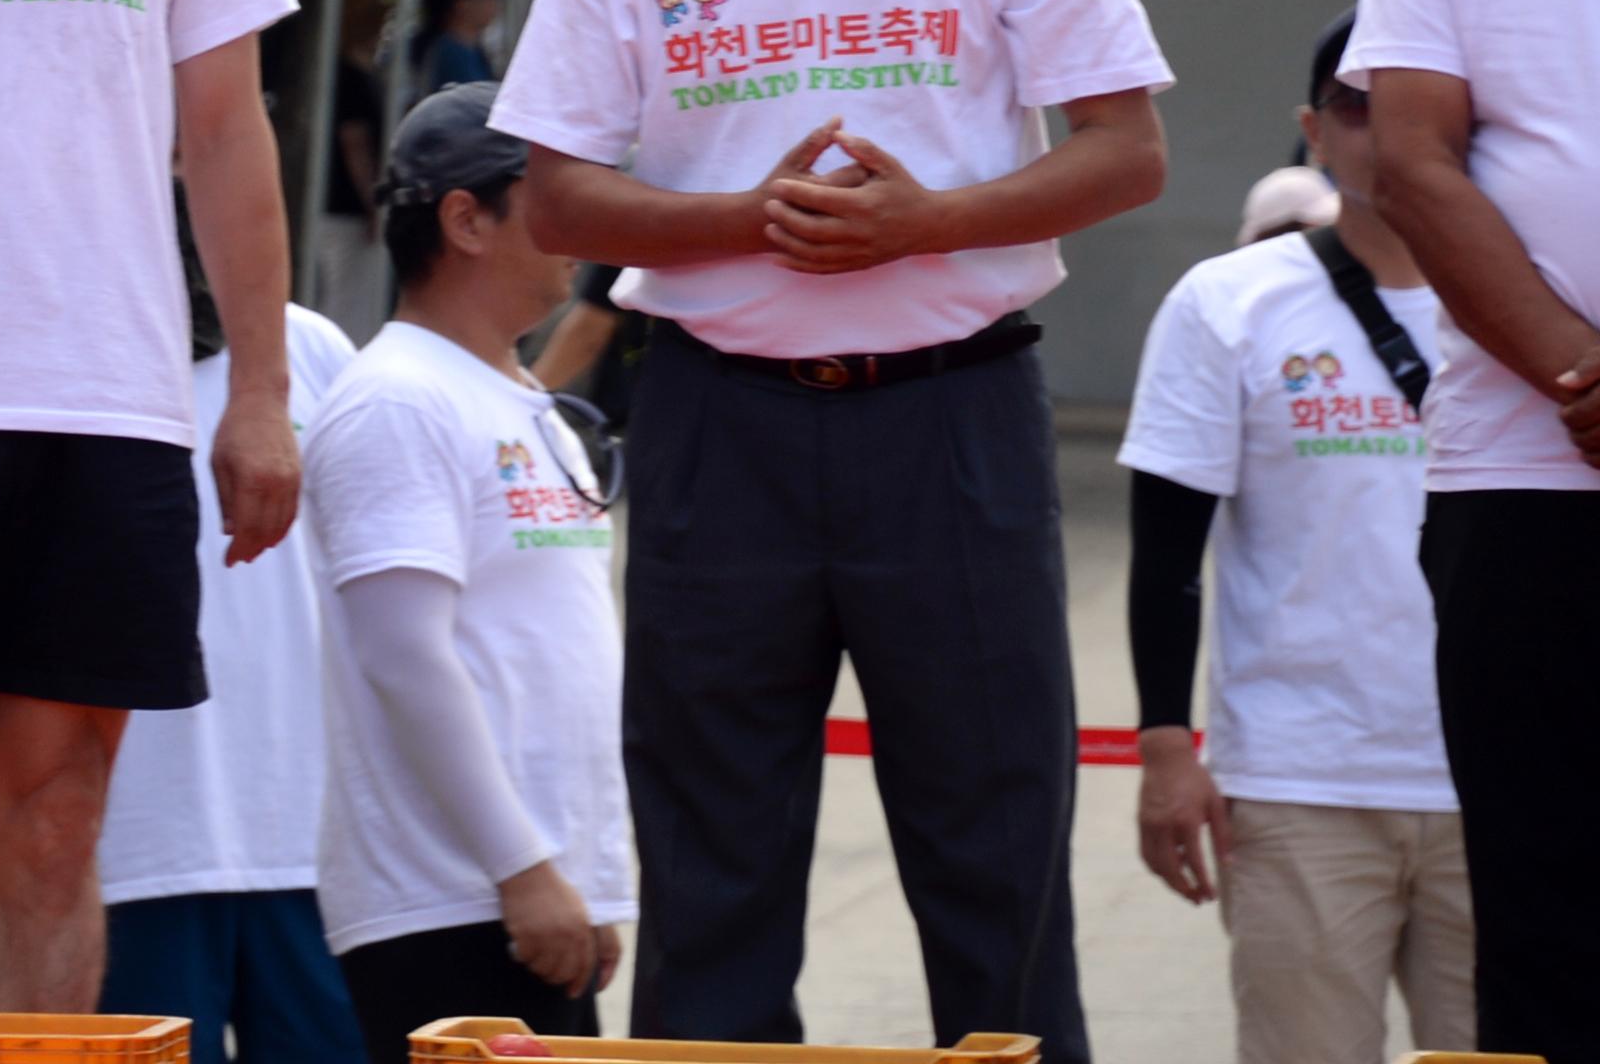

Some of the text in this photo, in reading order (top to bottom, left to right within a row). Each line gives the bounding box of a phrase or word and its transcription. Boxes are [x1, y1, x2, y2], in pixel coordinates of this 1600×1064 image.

[663, 6, 960, 79] 화천토마토축제
[671, 62, 960, 111] TOMATO FESTIVAL
[1294, 436, 1410, 457] TOMATO
